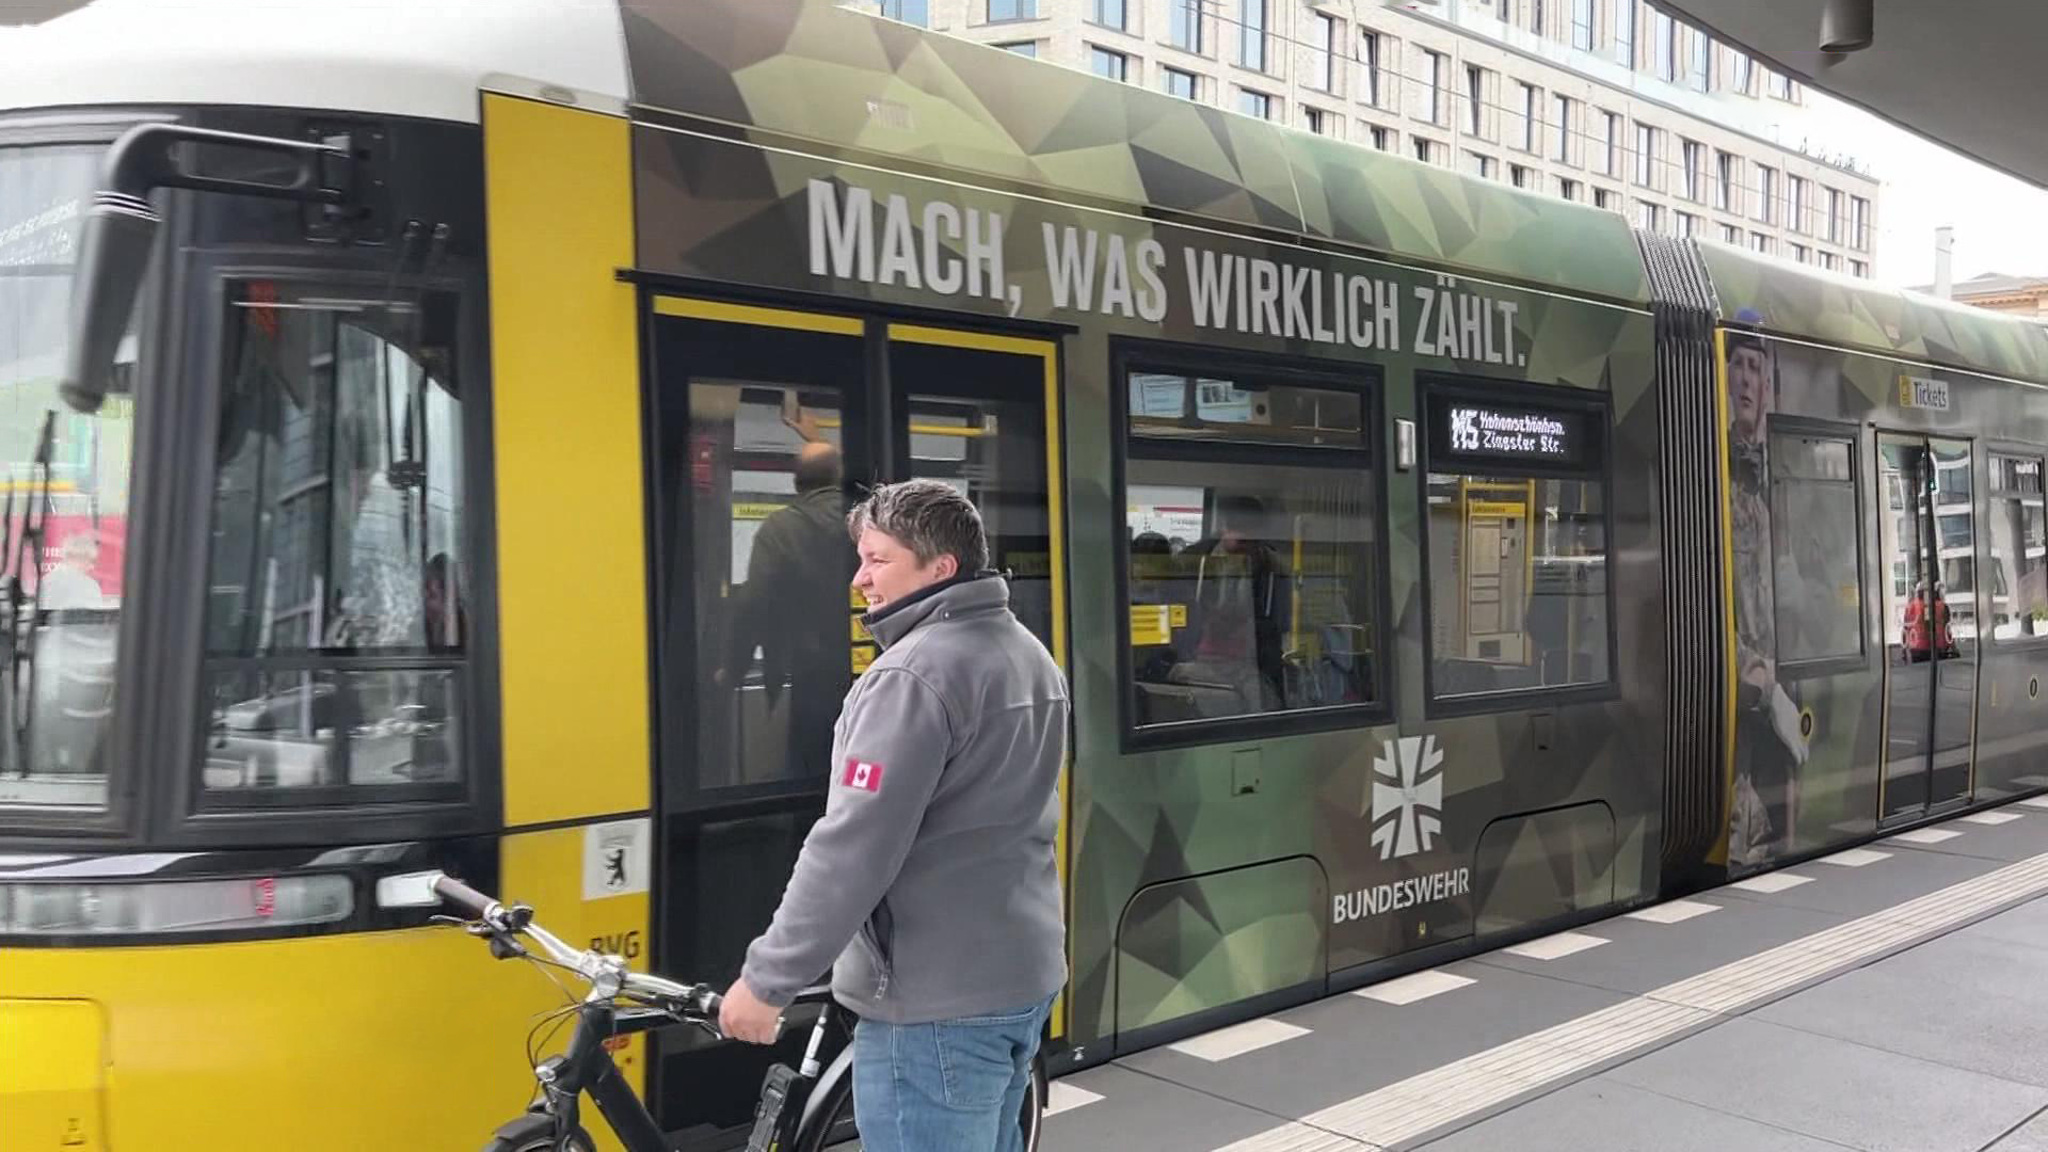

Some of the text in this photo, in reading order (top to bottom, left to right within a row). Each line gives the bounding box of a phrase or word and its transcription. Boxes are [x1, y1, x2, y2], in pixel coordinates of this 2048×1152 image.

[808, 178, 1526, 367] MACH, WAS WIRKLICH ZÄHLT.
[1913, 381, 1947, 408] Tickets
[1451, 408, 1480, 450] M5
[1482, 429, 1565, 453] Zingster Str.
[1333, 867, 1470, 924] BUNDESWEHR
